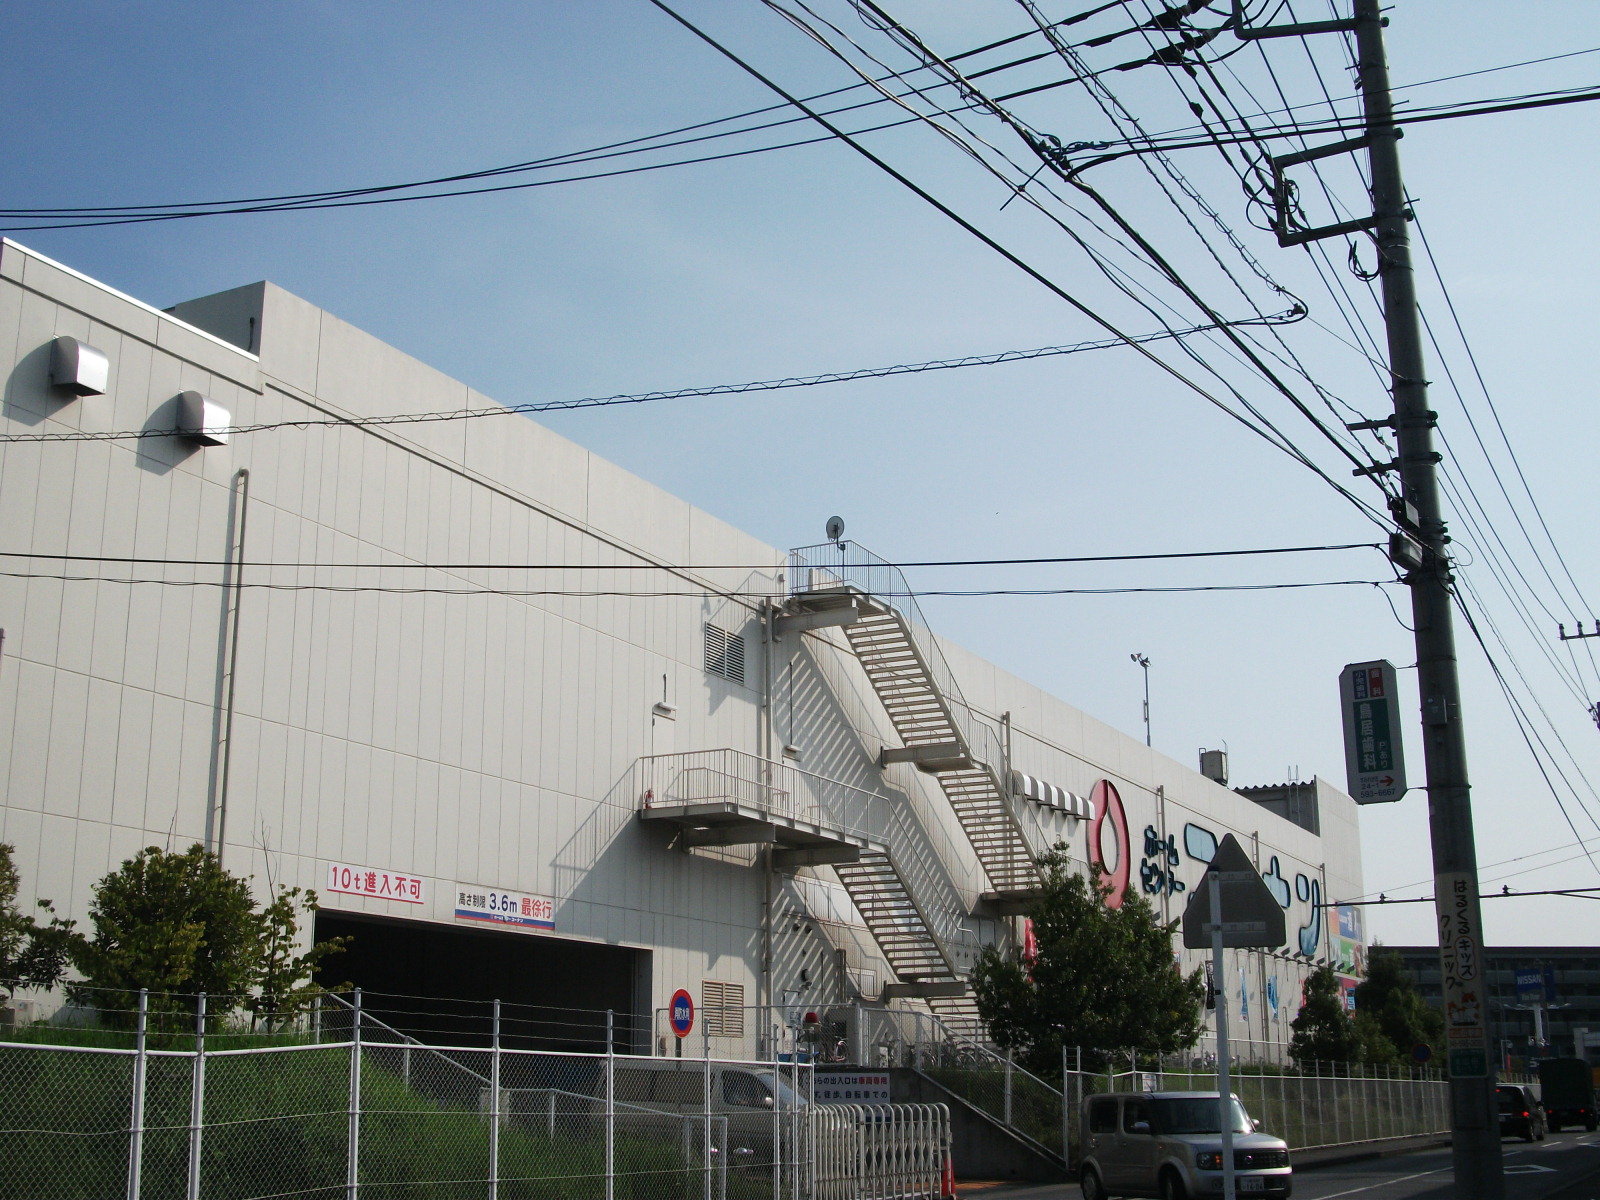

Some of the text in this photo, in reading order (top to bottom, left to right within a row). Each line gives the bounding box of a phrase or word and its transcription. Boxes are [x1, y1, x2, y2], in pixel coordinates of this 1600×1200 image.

[332, 866, 422, 900] 10t進入不可
[458, 892, 552, 920] 高さ制限 3.6m 最徐行
[1440, 915, 1458, 991] クリニック
[1516, 974, 1542, 985] NISSAN
